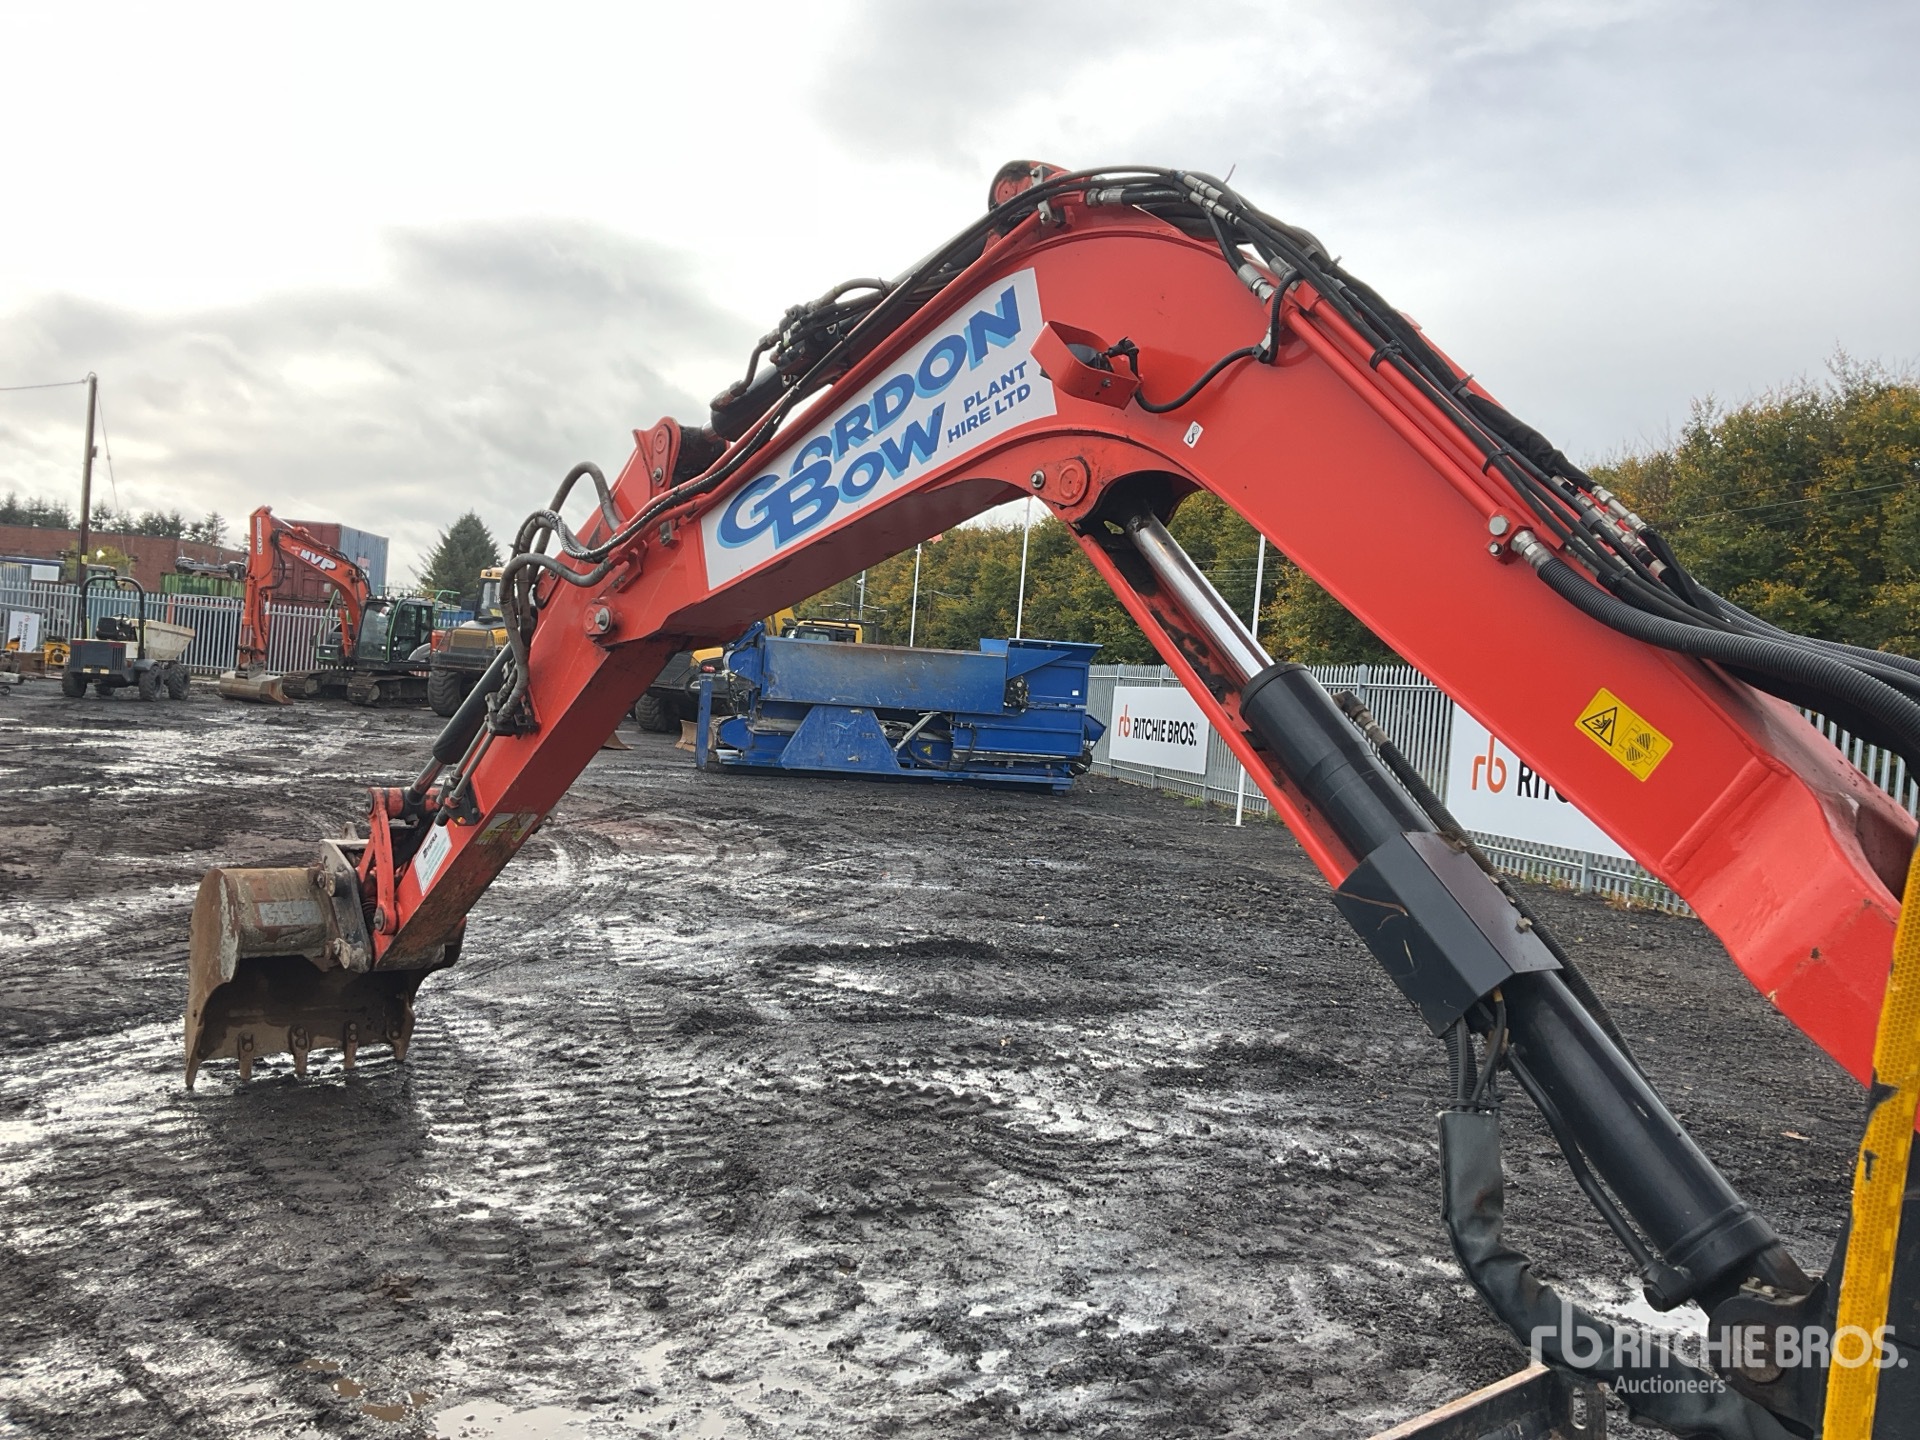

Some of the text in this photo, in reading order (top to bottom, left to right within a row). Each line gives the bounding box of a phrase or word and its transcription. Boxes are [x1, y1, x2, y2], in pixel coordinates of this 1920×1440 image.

[947, 384, 1031, 443] HIRE LTD
[964, 361, 1028, 413] PLANT
[717, 285, 1021, 549] GORDON
[774, 402, 946, 549] BOW
[300, 549, 337, 571] MVP
[1133, 717, 1167, 742] RITCHIE
[1167, 720, 1197, 746] BROS.
